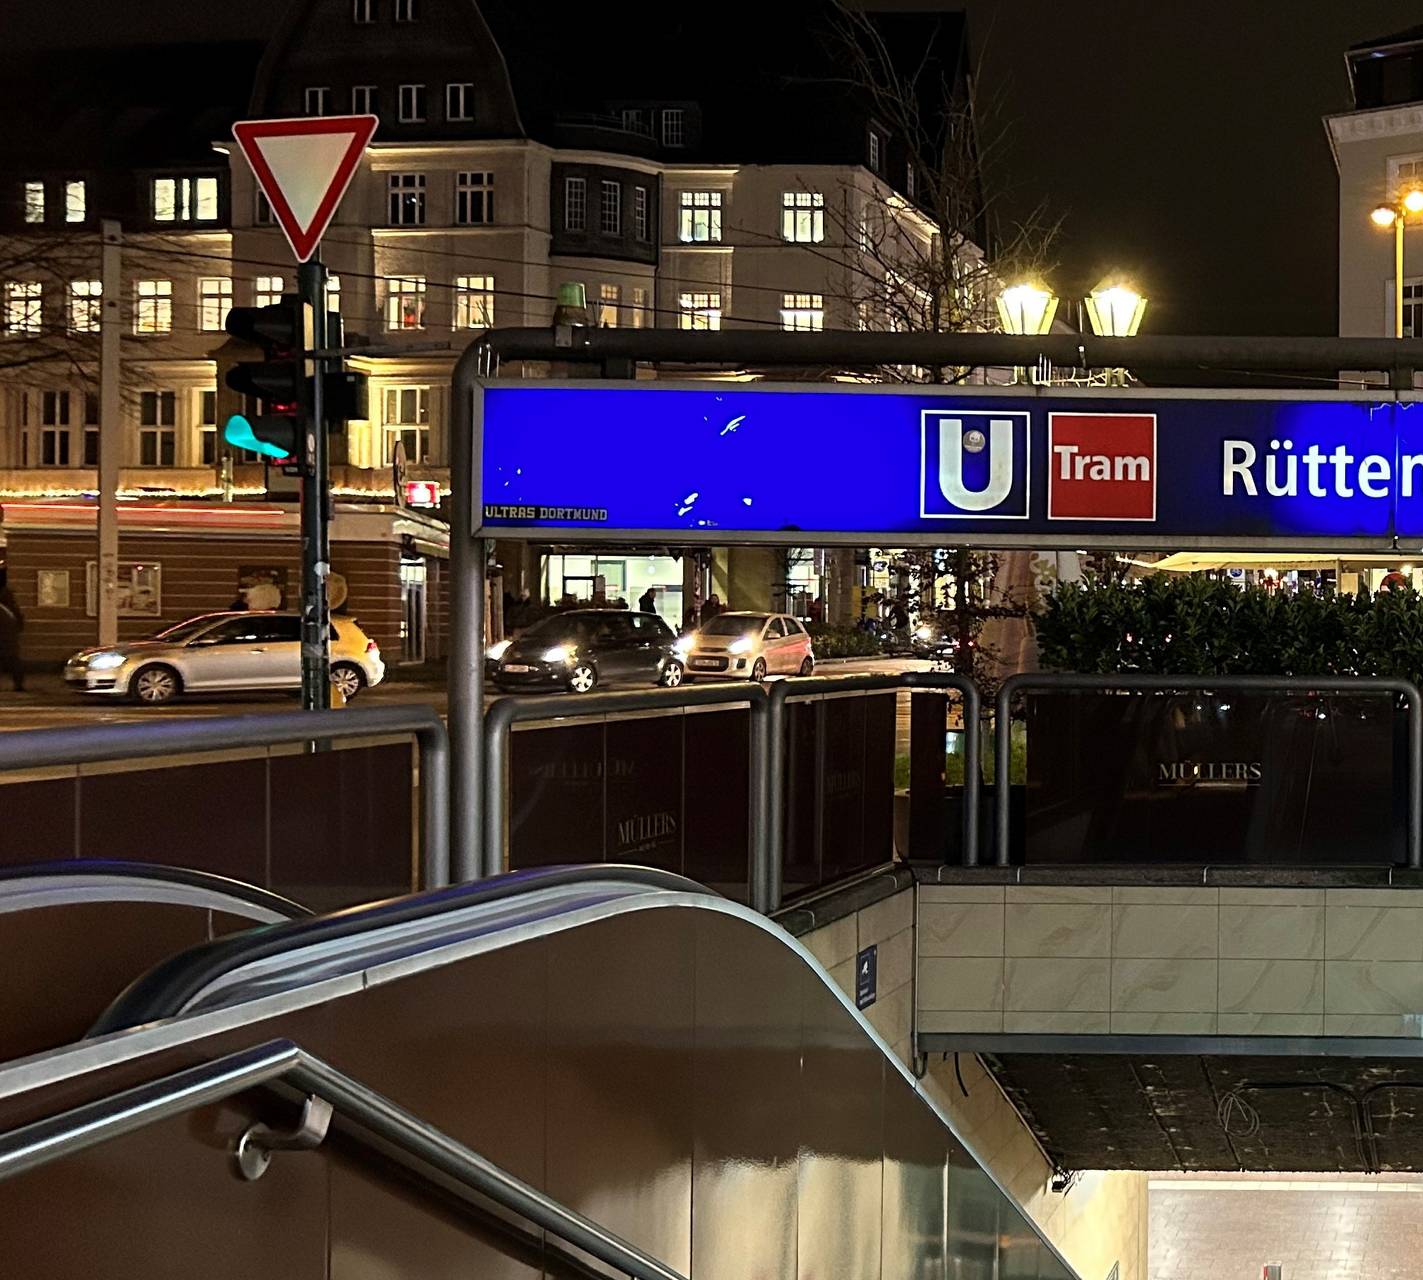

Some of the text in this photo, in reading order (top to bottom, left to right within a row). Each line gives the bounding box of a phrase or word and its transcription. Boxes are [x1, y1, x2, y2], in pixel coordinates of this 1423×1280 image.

[938, 418, 1012, 511] U
[1053, 445, 1151, 481] Tram
[485, 505, 607, 520] ULTRAS DORTMUND
[1159, 760, 1262, 780] MÜLLERS
